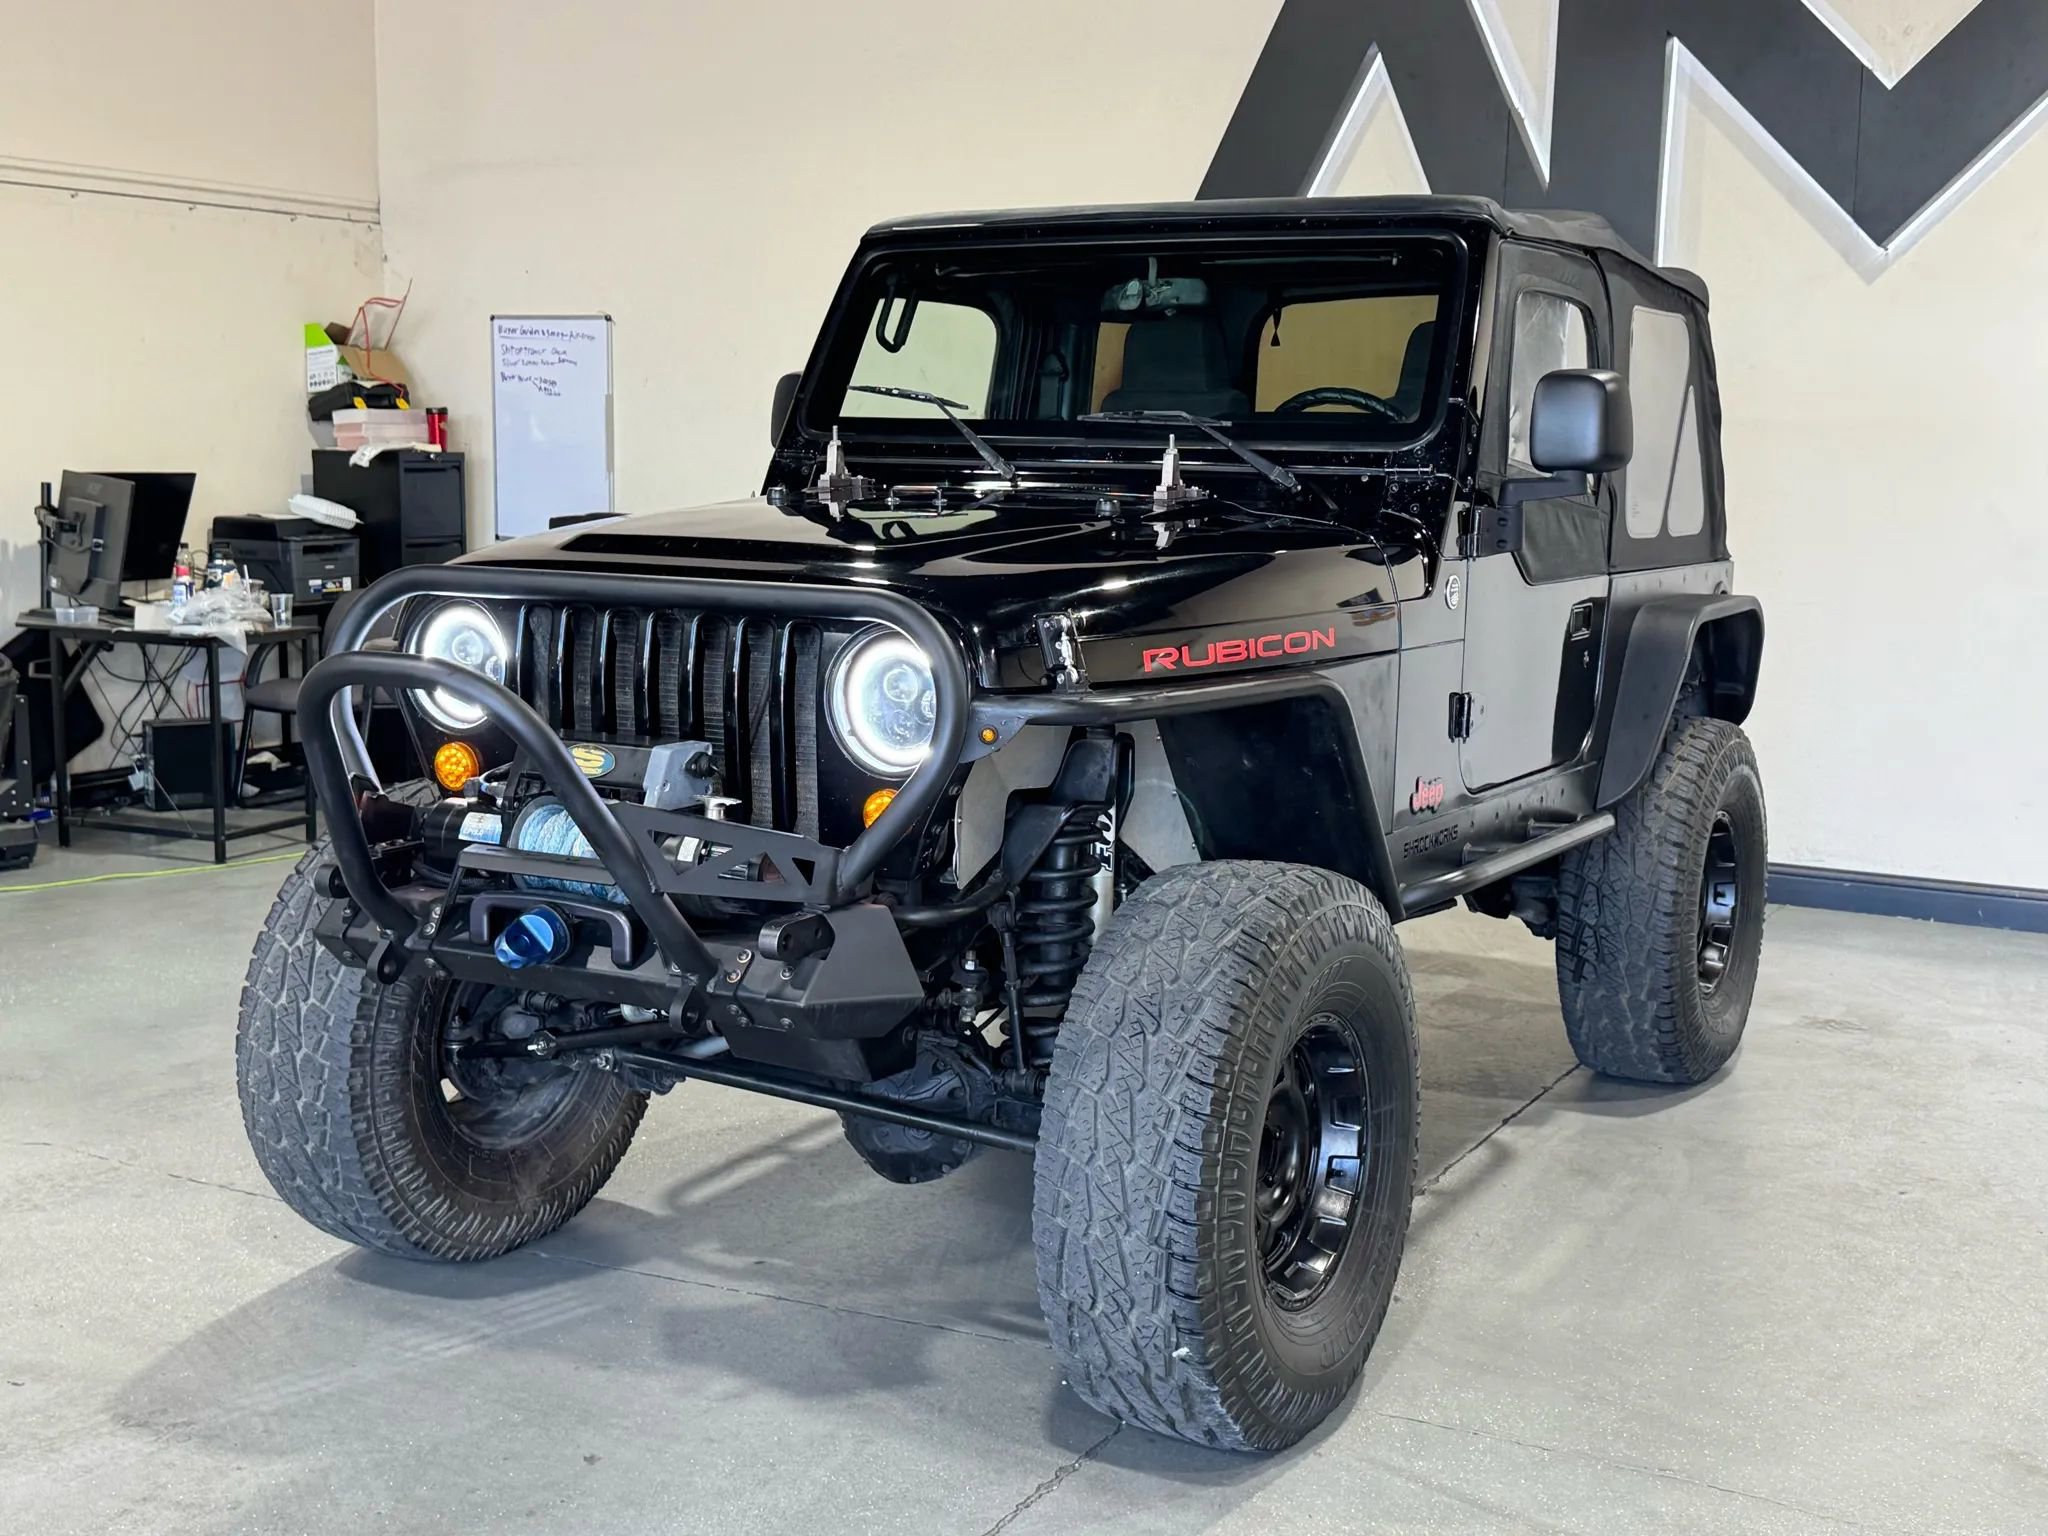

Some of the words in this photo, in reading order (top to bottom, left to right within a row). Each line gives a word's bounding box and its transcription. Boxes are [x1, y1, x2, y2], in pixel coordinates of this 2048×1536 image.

[1142, 626, 1336, 673] RUBICON
[1410, 776, 1444, 815] Jeep
[1403, 824, 1459, 860] SHROCKWORKS
